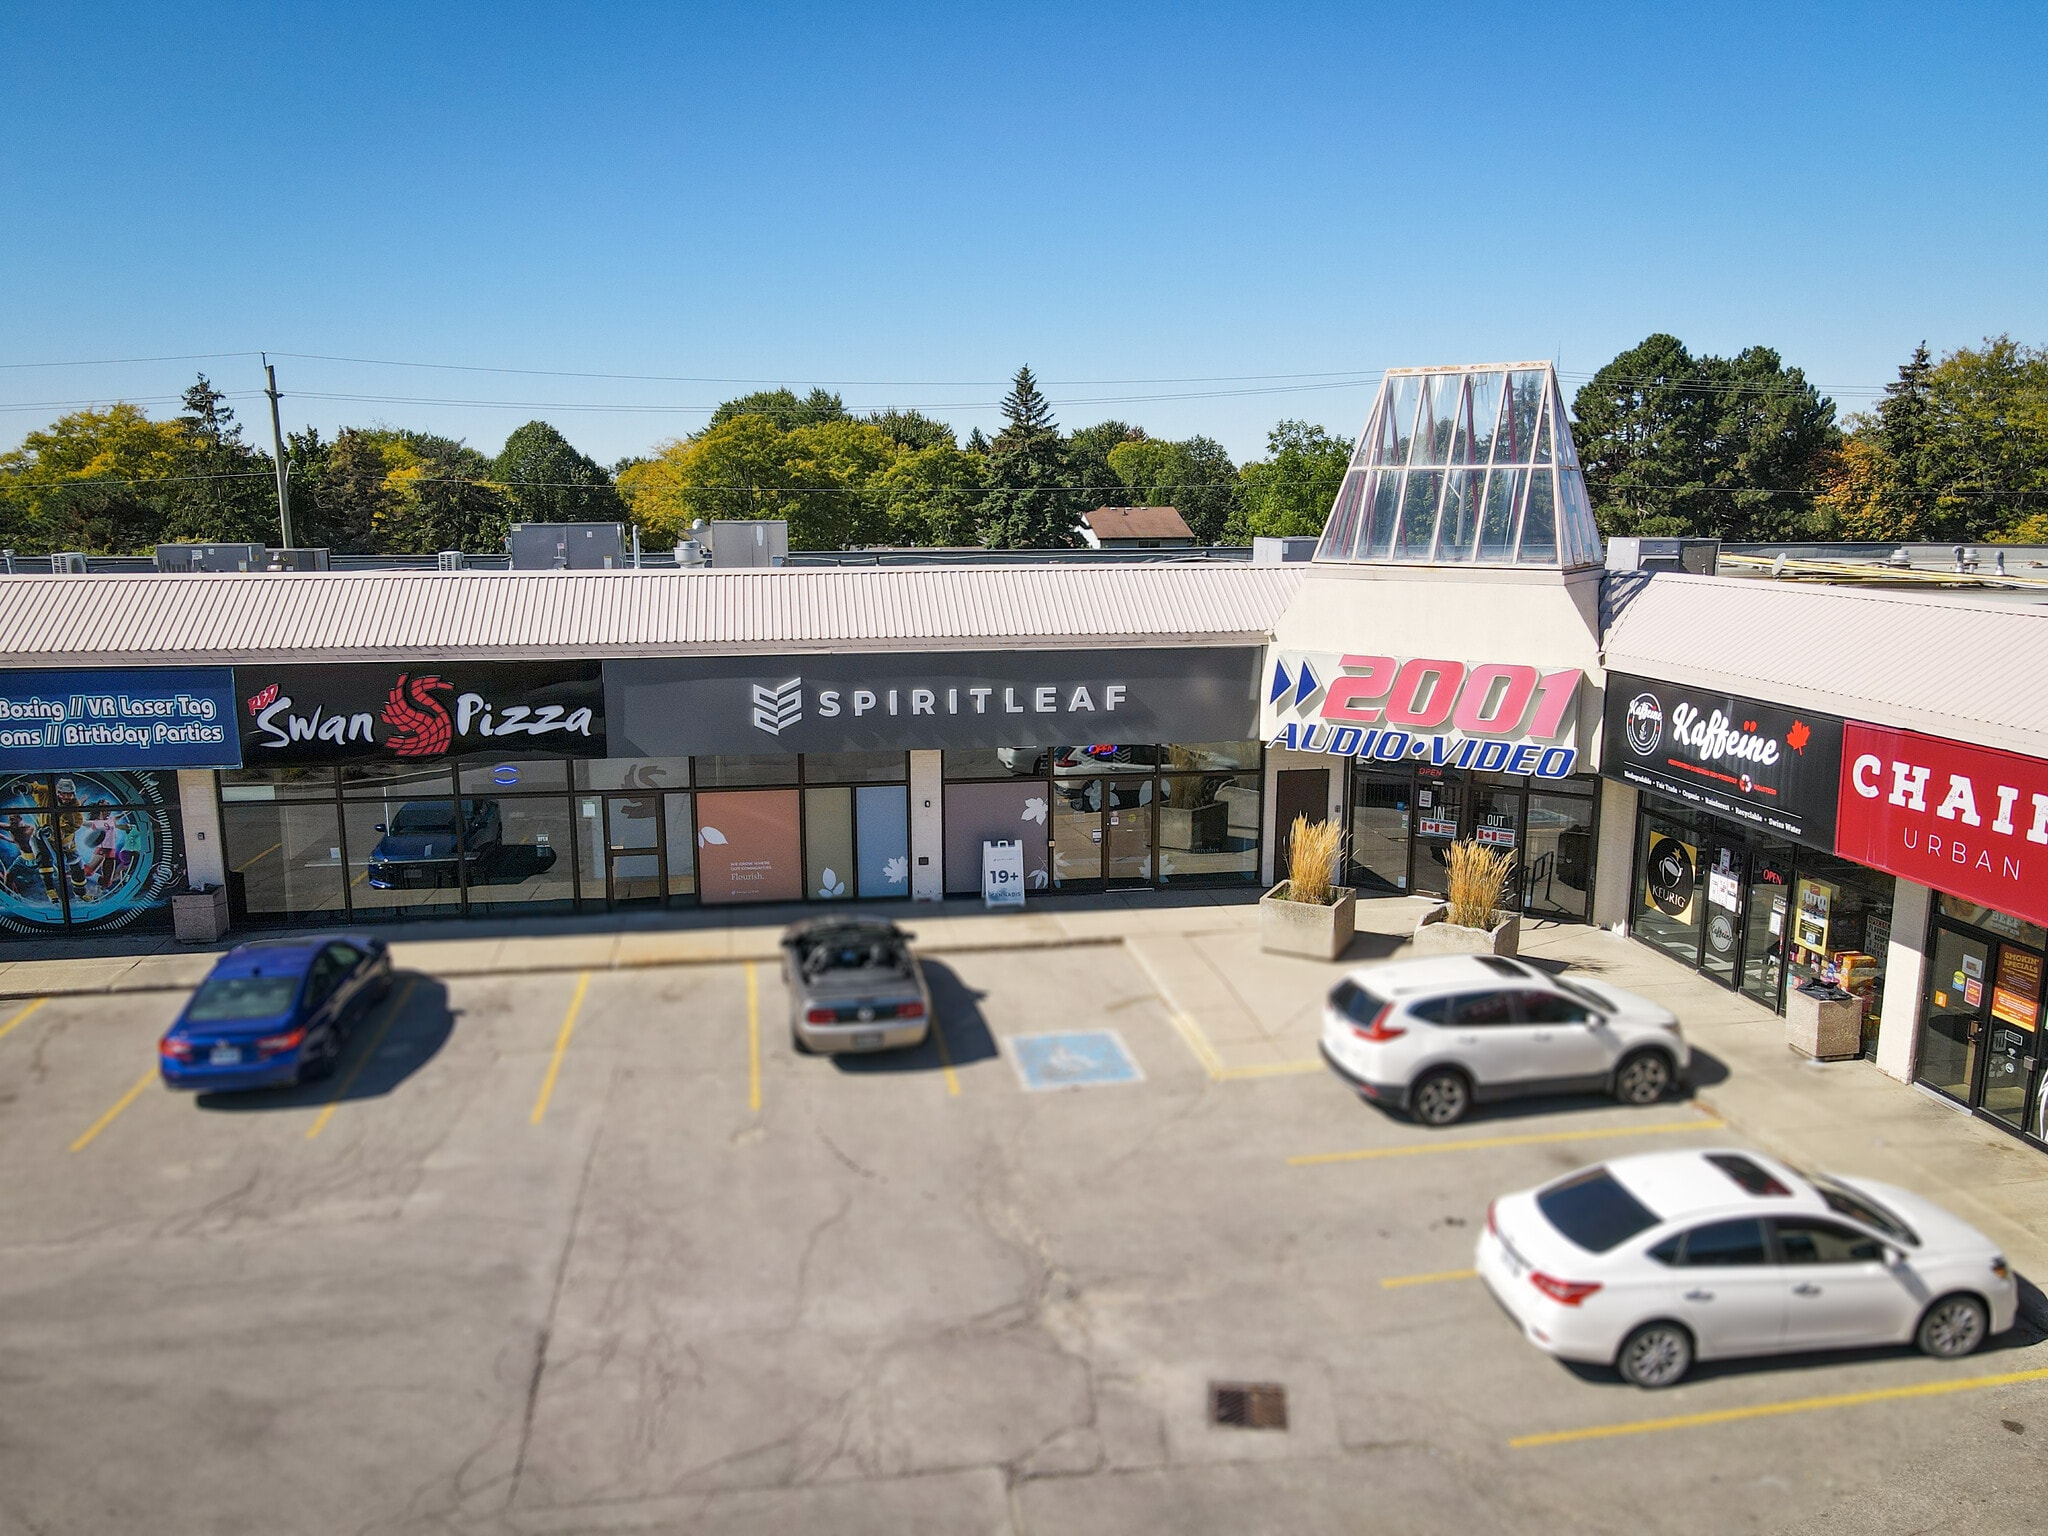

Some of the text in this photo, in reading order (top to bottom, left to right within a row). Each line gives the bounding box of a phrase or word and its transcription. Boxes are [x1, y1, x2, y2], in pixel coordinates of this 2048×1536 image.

[818, 686, 1127, 717] SPIRITLEAF
[1320, 653, 1584, 739] 2001
[0, 698, 66, 722] Boxing
[87, 697, 117, 717] VR
[120, 697, 174, 716] Laser
[177, 696, 215, 720] Tag
[256, 693, 592, 747] Swan Pizza
[0, 731, 42, 746] oms
[65, 725, 150, 747] Birthday
[155, 724, 223, 743] Parties
[1419, 768, 1442, 776] OPEN
[1433, 806, 1445, 820] IN
[1487, 814, 1505, 827] OUT
[1903, 827, 2020, 881] URBAN
[990, 870, 1019, 884] 19+
[1763, 868, 1783, 886] OPEN
[1652, 884, 1686, 908] KEURIG
[2003, 959, 2039, 974] SPECIALS
[2004, 951, 2040, 965] SMOKIN'
